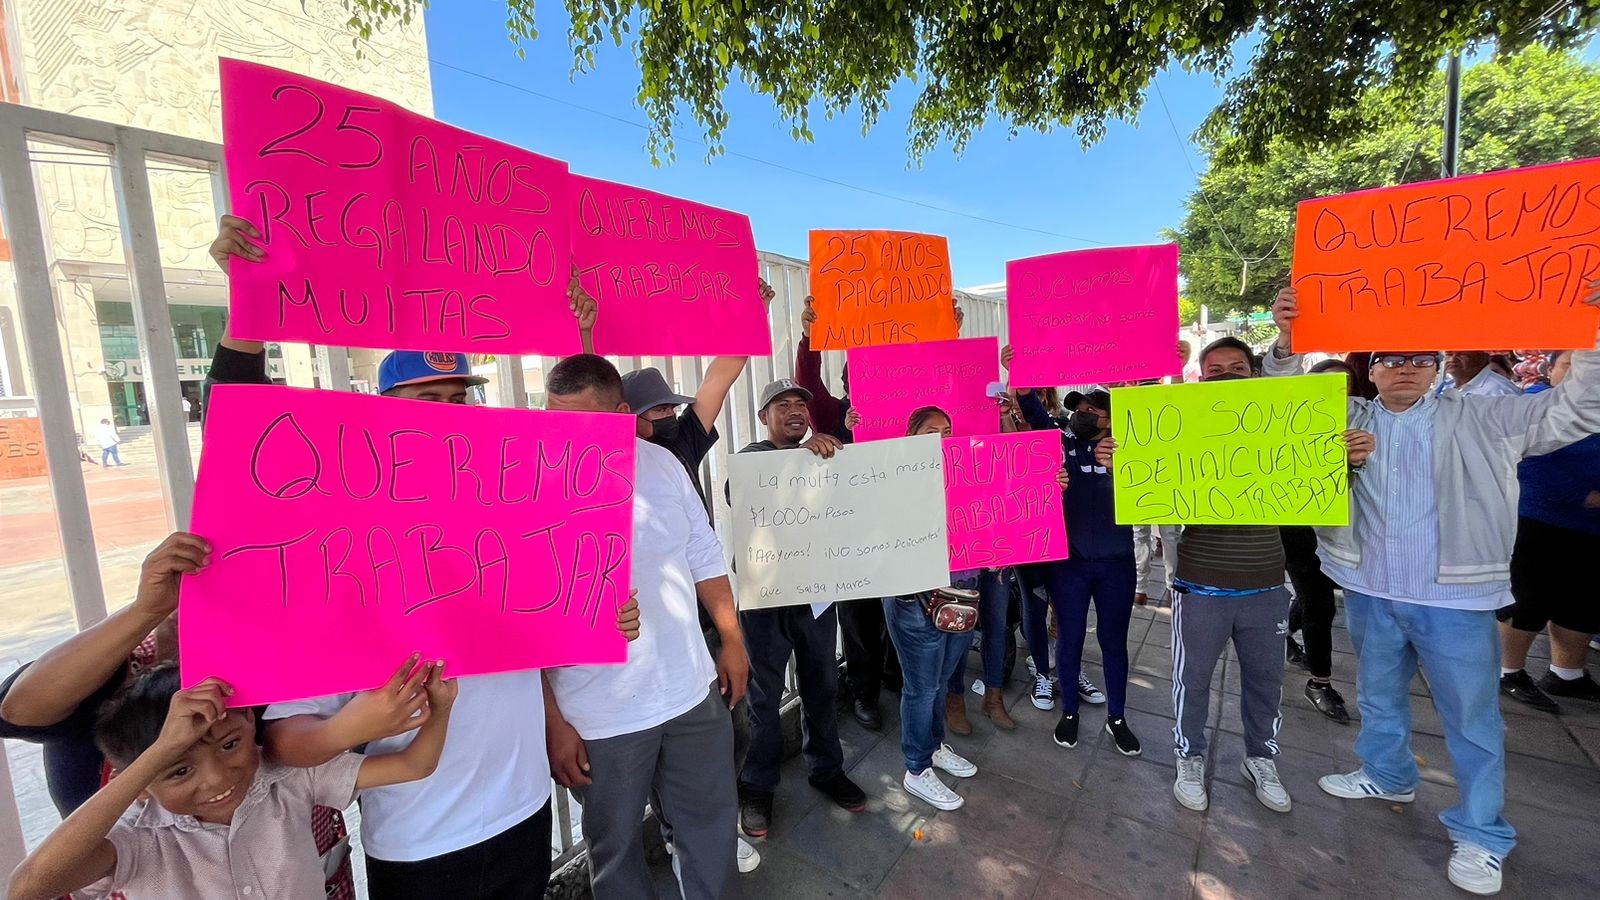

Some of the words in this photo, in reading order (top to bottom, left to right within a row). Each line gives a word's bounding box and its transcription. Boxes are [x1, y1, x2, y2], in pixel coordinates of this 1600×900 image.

[257, 85, 384, 169] 25
[409, 134, 551, 215] AÑOS
[245, 179, 557, 287] REGALANDO
[579, 187, 741, 247] QUEREMOS
[1313, 180, 1600, 253] QUEREMOS
[819, 233, 868, 275] 25
[881, 235, 944, 272] AÑOS
[580, 261, 741, 301] TRABAJAR
[834, 273, 950, 311] PAGANDO
[1123, 403, 1182, 449] NO
[1202, 398, 1338, 439] SOMOS
[250, 412, 635, 515] QUEREMOS
[757, 471, 779, 489] La
[789, 468, 839, 489] multa
[848, 466, 888, 487] esta
[942, 439, 1054, 490] REMOS
[825, 506, 856, 520] Pesos
[946, 484, 1057, 535] ABAJAR
[221, 520, 628, 629] TRABAJAR
